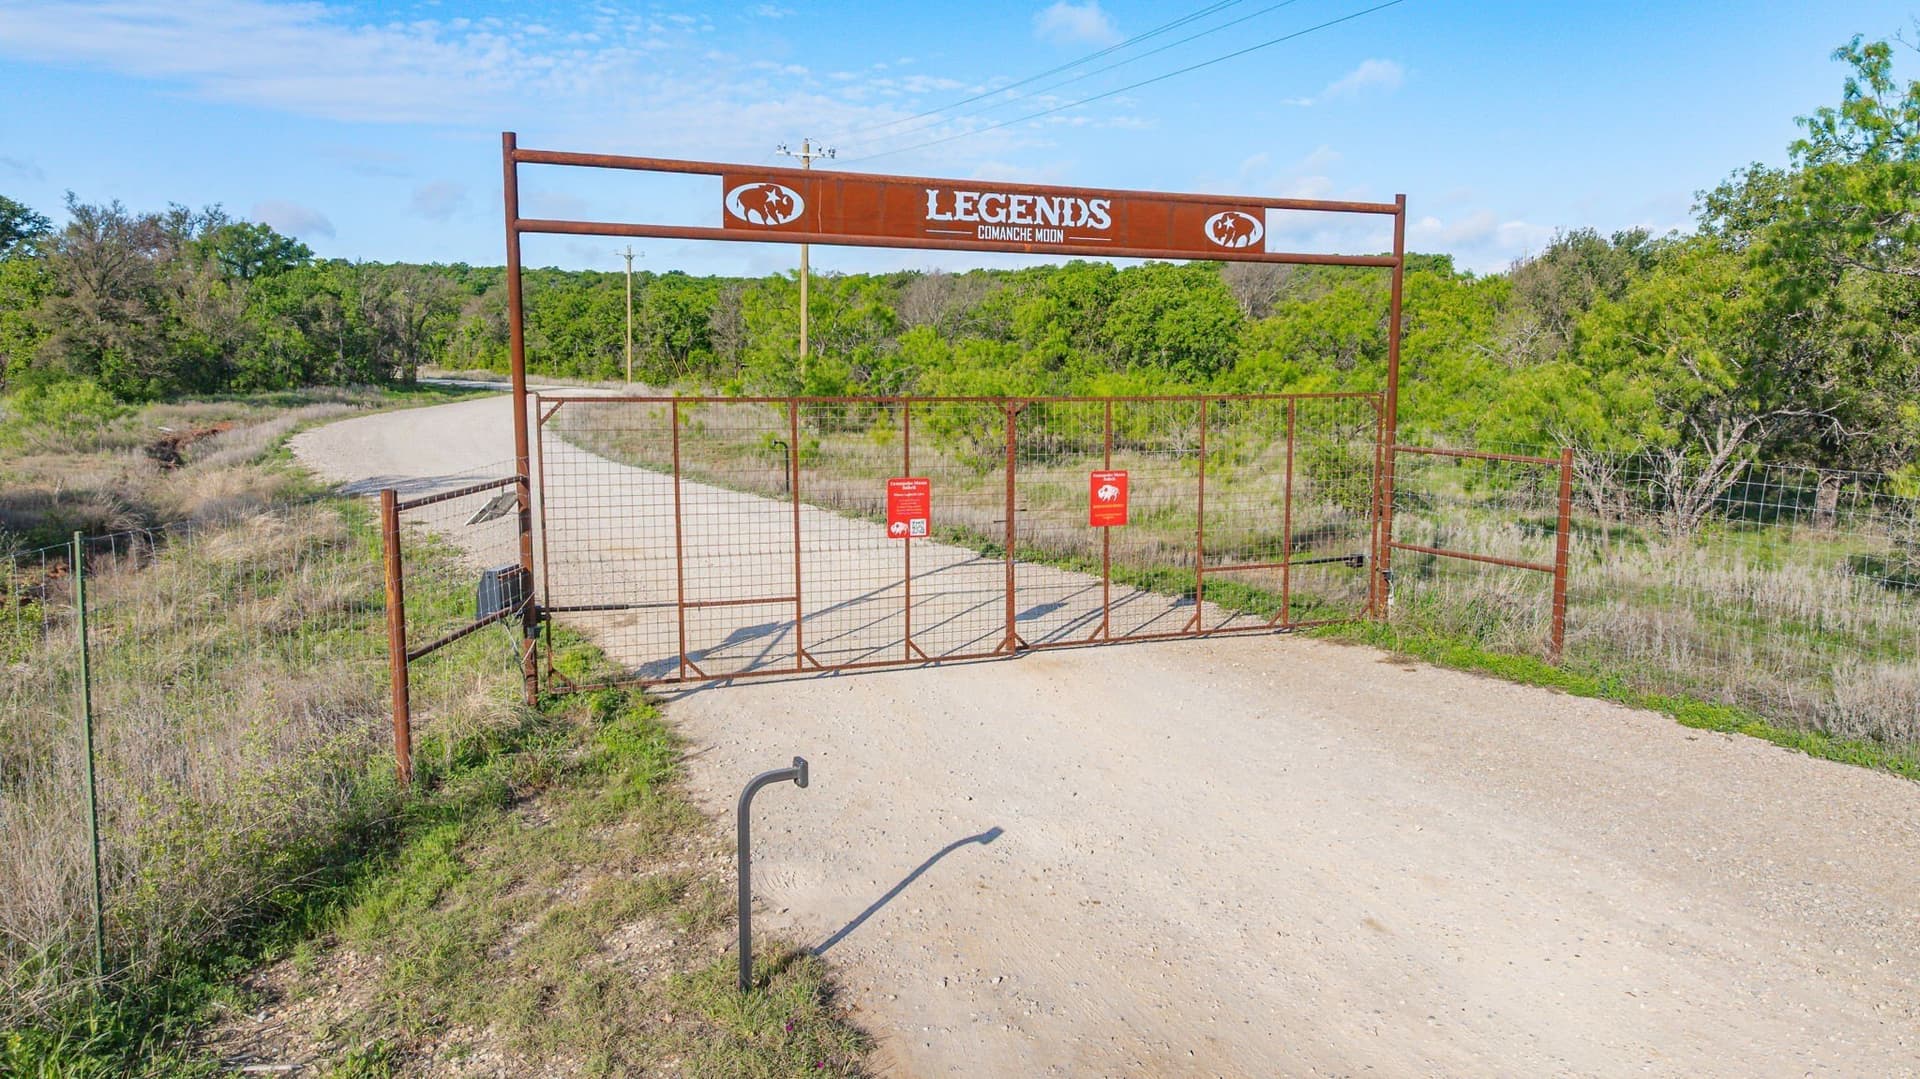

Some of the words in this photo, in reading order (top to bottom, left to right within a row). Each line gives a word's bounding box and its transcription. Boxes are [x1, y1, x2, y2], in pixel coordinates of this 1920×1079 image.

[925, 189, 1112, 230] LEGENDS
[977, 225, 1033, 242] COMANCHE
[1035, 228, 1064, 243] MOON
